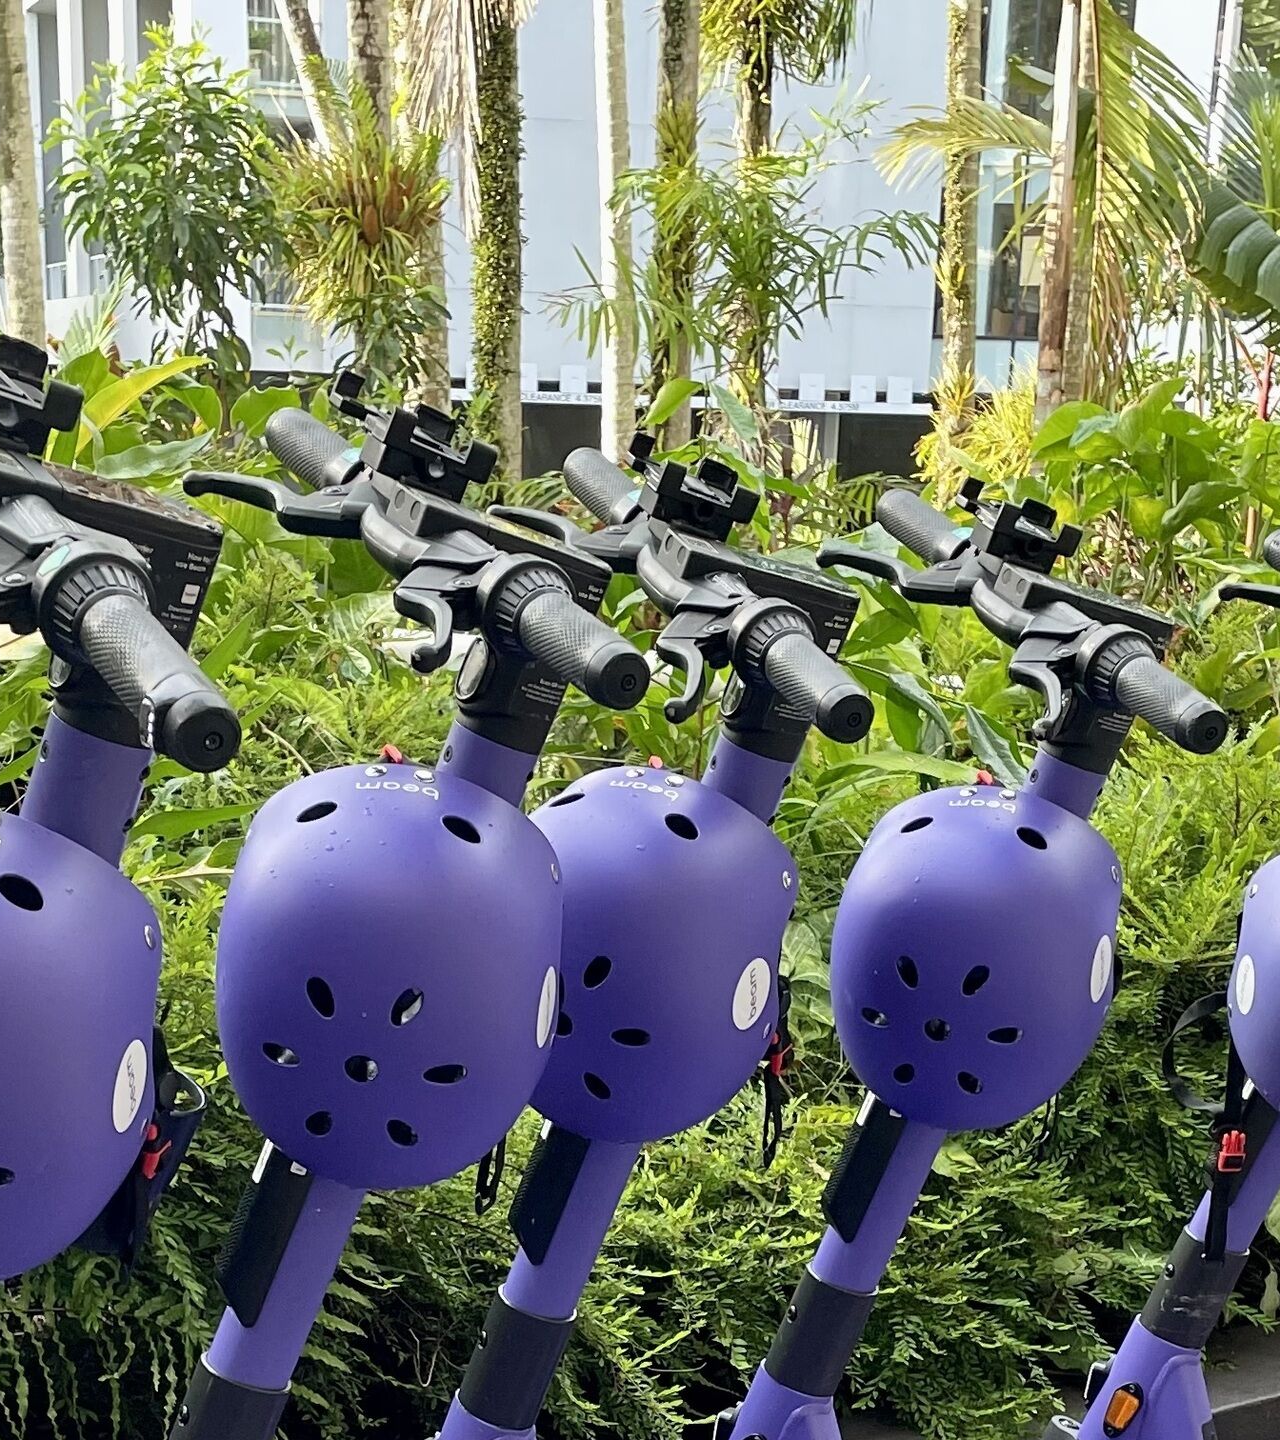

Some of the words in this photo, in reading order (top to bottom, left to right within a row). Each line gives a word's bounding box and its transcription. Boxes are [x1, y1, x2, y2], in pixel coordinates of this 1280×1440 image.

[356, 781, 440, 800] beam
[609, 779, 680, 801] beam
[949, 799, 1016, 814] beam
